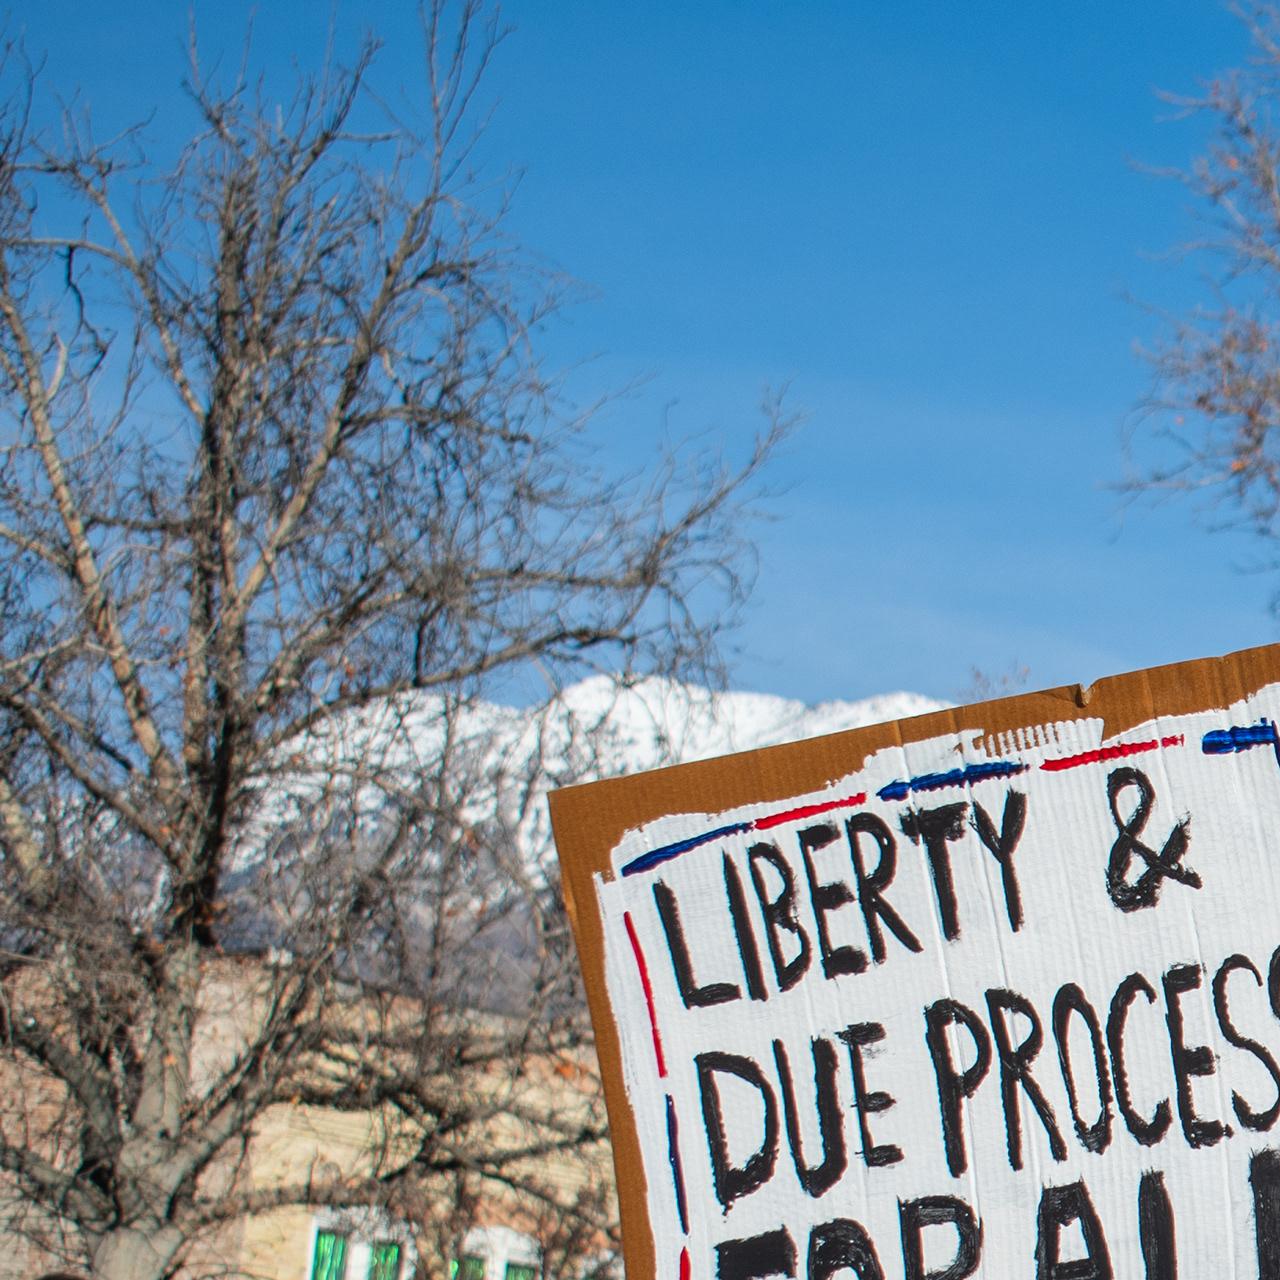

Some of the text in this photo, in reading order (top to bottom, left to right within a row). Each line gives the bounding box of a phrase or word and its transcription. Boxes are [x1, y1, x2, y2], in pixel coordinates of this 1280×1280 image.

[652, 766, 1203, 1009] LIBERTY &
[693, 1021, 905, 1214] DUE
